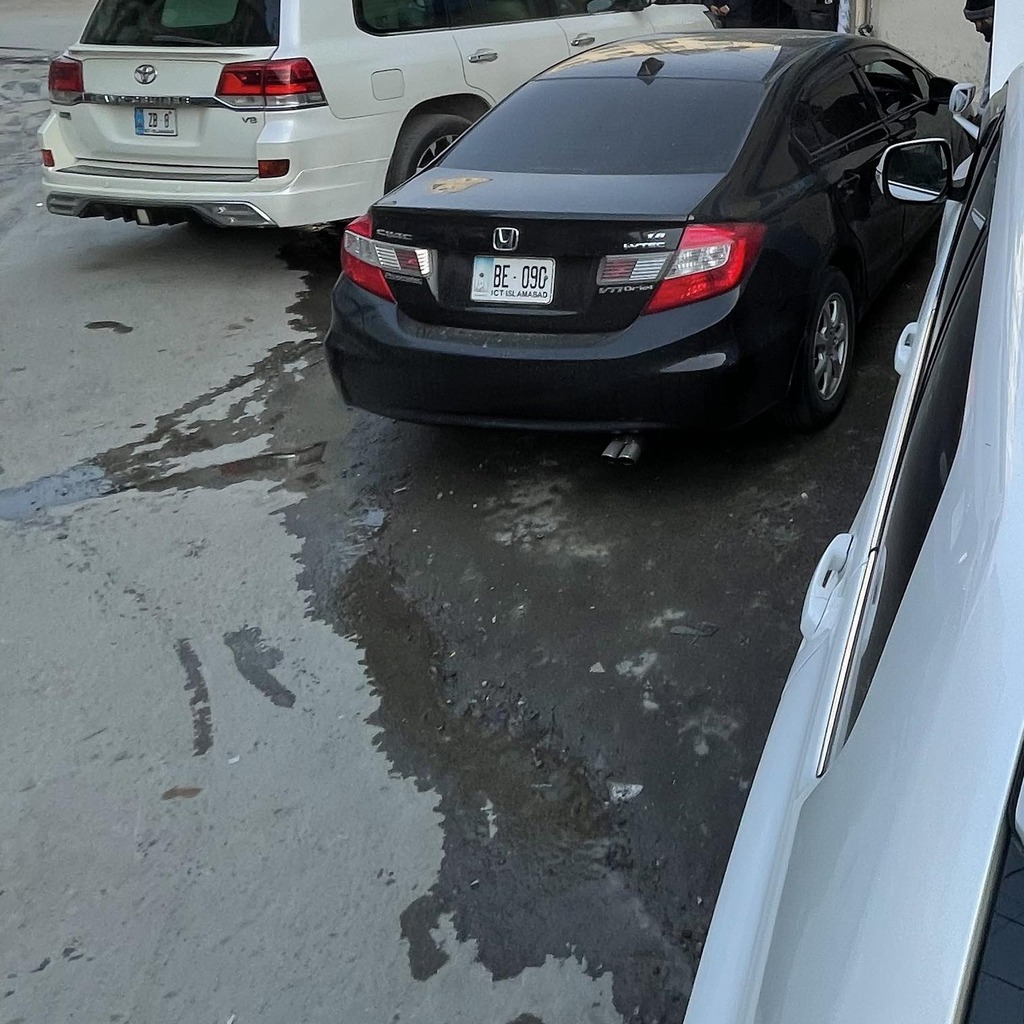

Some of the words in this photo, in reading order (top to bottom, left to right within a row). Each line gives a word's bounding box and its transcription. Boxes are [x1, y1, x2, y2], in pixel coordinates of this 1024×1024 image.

[242, 116, 257, 124] V8
[494, 264, 511, 288] BE
[490, 289, 504, 297] ICT
[505, 289, 548, 298] ISLAMABAD
